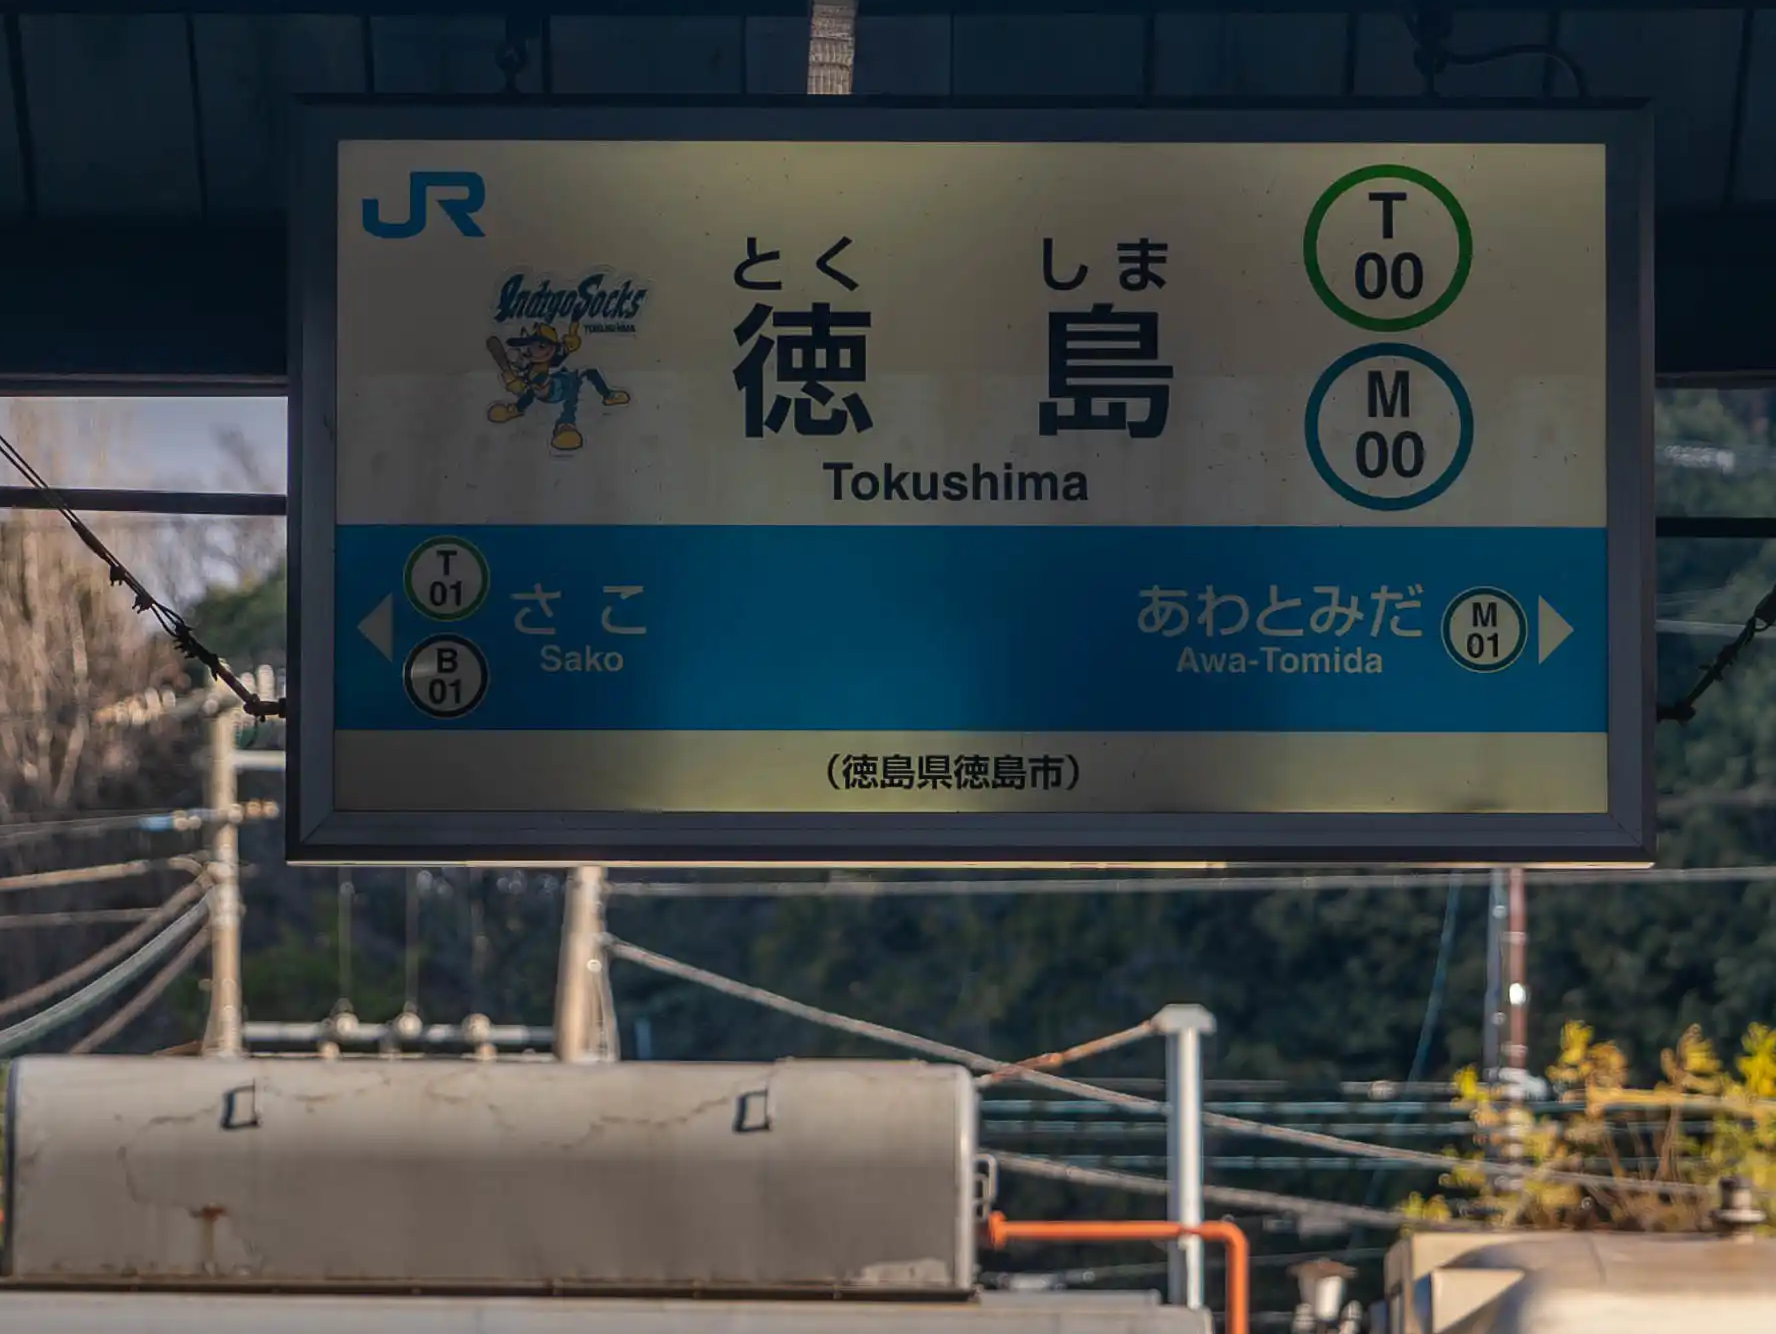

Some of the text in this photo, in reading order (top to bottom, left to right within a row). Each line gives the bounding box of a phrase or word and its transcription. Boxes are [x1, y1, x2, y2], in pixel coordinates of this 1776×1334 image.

[362, 171, 487, 239] JR
[1368, 193, 1409, 240] T
[1353, 253, 1425, 303] 00
[1368, 371, 1411, 419] M
[1353, 431, 1426, 480] 00
[823, 462, 1090, 503] Tokushima
[436, 550, 458, 576] T
[428, 581, 464, 609] 01
[1135, 584, 1424, 639] あわとみだ
[1471, 603, 1498, 629] M
[540, 645, 626, 674] Sako
[1465, 631, 1503, 658] 01
[436, 648, 459, 676] B
[1175, 645, 1385, 676] Awa-Tomida
[428, 679, 464, 706] 01
